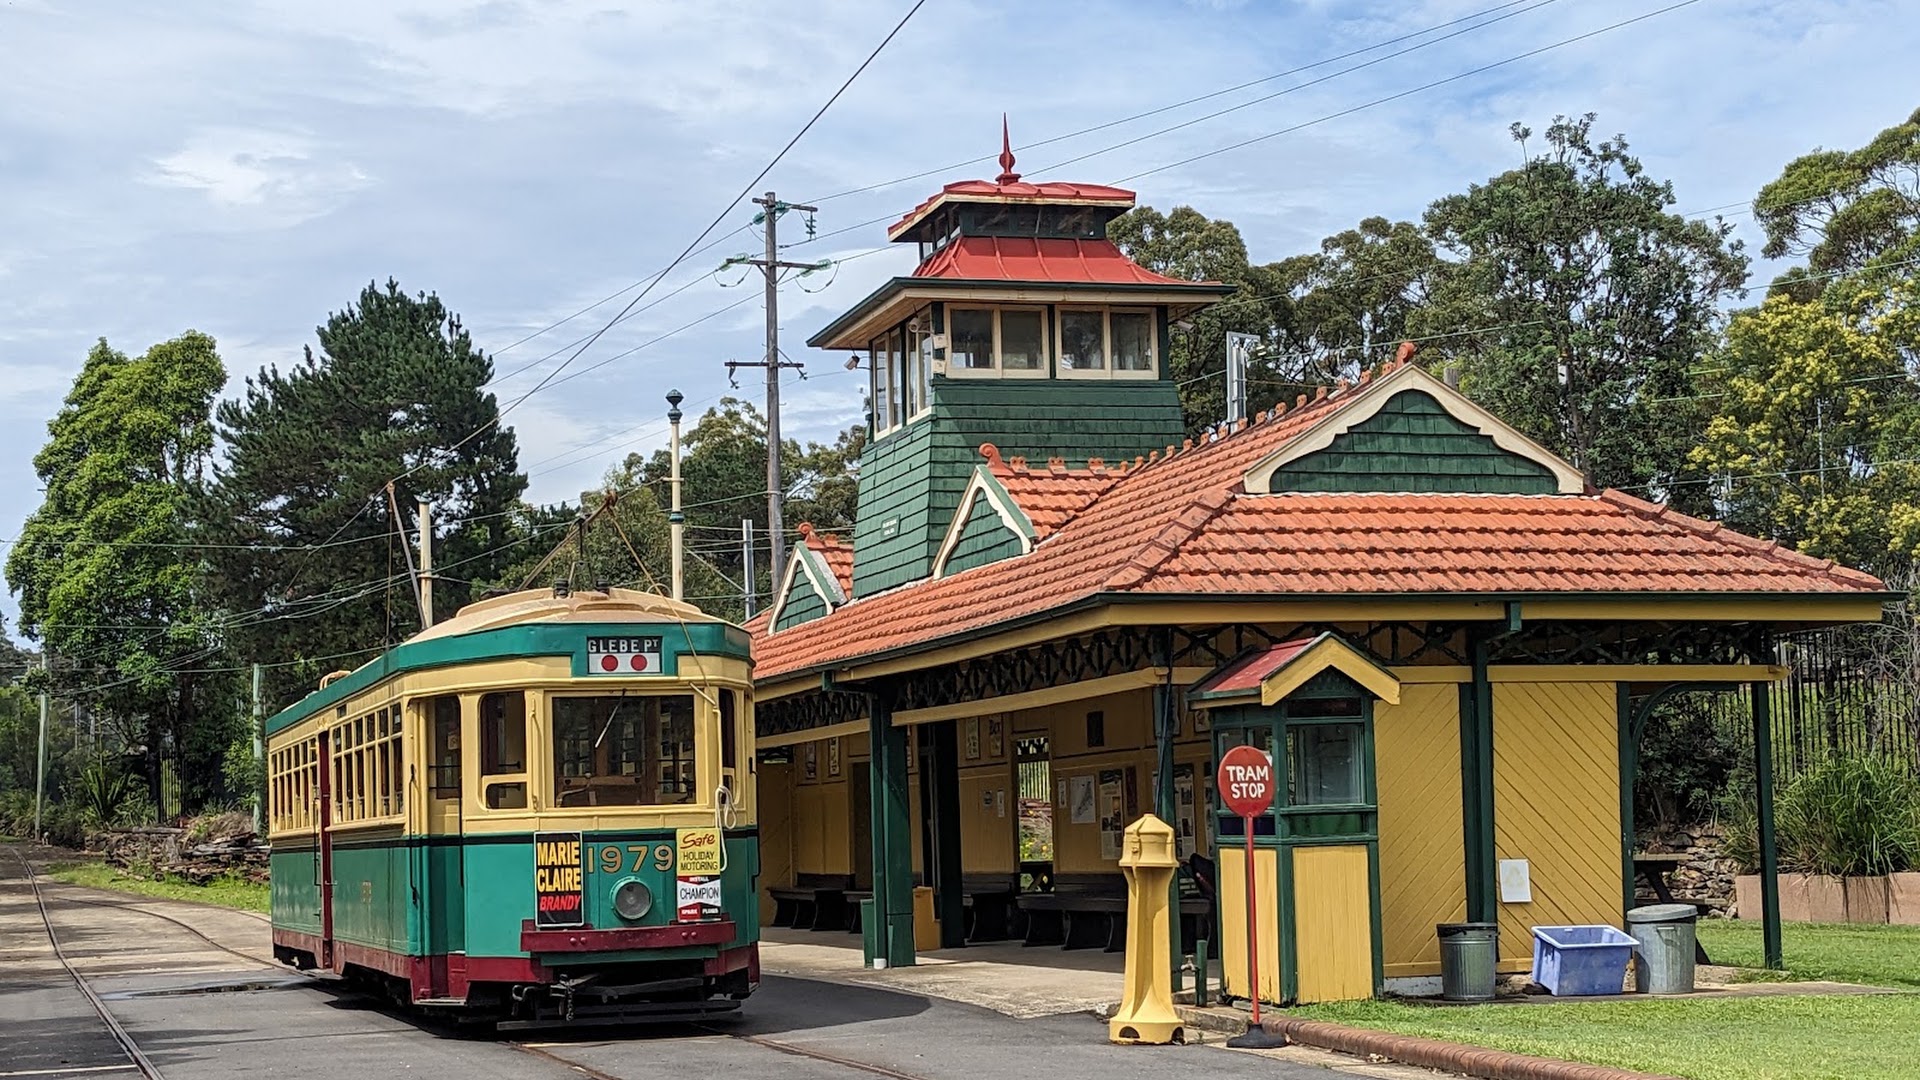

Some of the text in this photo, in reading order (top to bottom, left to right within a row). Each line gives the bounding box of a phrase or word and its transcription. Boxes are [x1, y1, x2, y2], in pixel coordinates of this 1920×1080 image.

[588, 639, 639, 653] GLEBE
[1225, 765, 1269, 782] TRAM
[1231, 782, 1265, 799] STOP
[680, 832, 716, 849] Safe
[537, 841, 580, 866] MARIE
[586, 844, 674, 874] 1979
[683, 851, 715, 861] HOLIDAY
[680, 861, 718, 871] MOTORING
[537, 867, 581, 892] CLAIRE
[680, 887, 719, 900] CHAMPION
[540, 895, 581, 911] BRANDY
